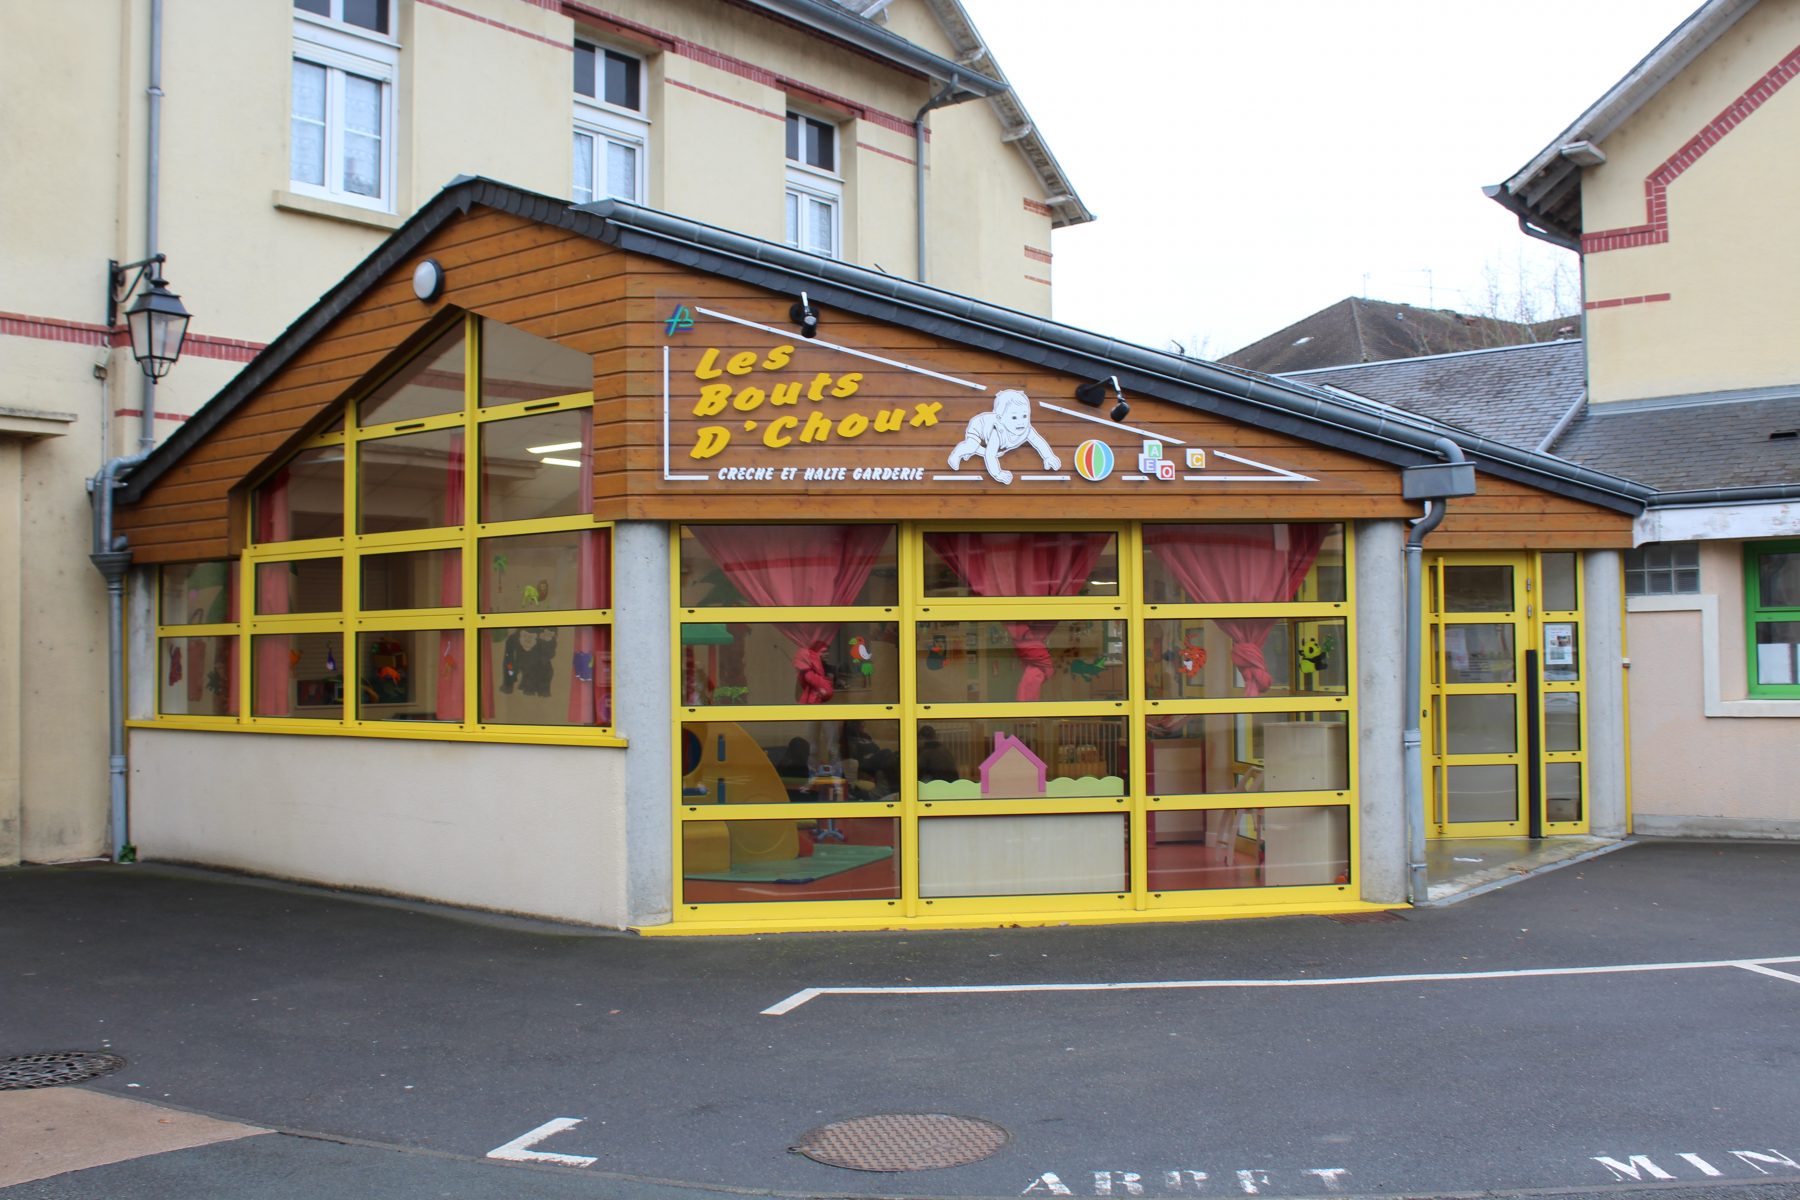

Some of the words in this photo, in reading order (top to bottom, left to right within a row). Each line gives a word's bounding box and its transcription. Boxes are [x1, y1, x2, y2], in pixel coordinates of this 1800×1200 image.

[695, 344, 795, 380] Les
[692, 372, 863, 417] Bouts
[690, 401, 943, 459] D'Choux
[1150, 446, 1160, 457] A
[1146, 459, 1155, 471] E
[1192, 454, 1202, 466] C
[718, 467, 775, 481] CRECHE
[781, 467, 798, 481] ET
[804, 467, 847, 481] HALTE
[852, 467, 925, 481] GARDERIE
